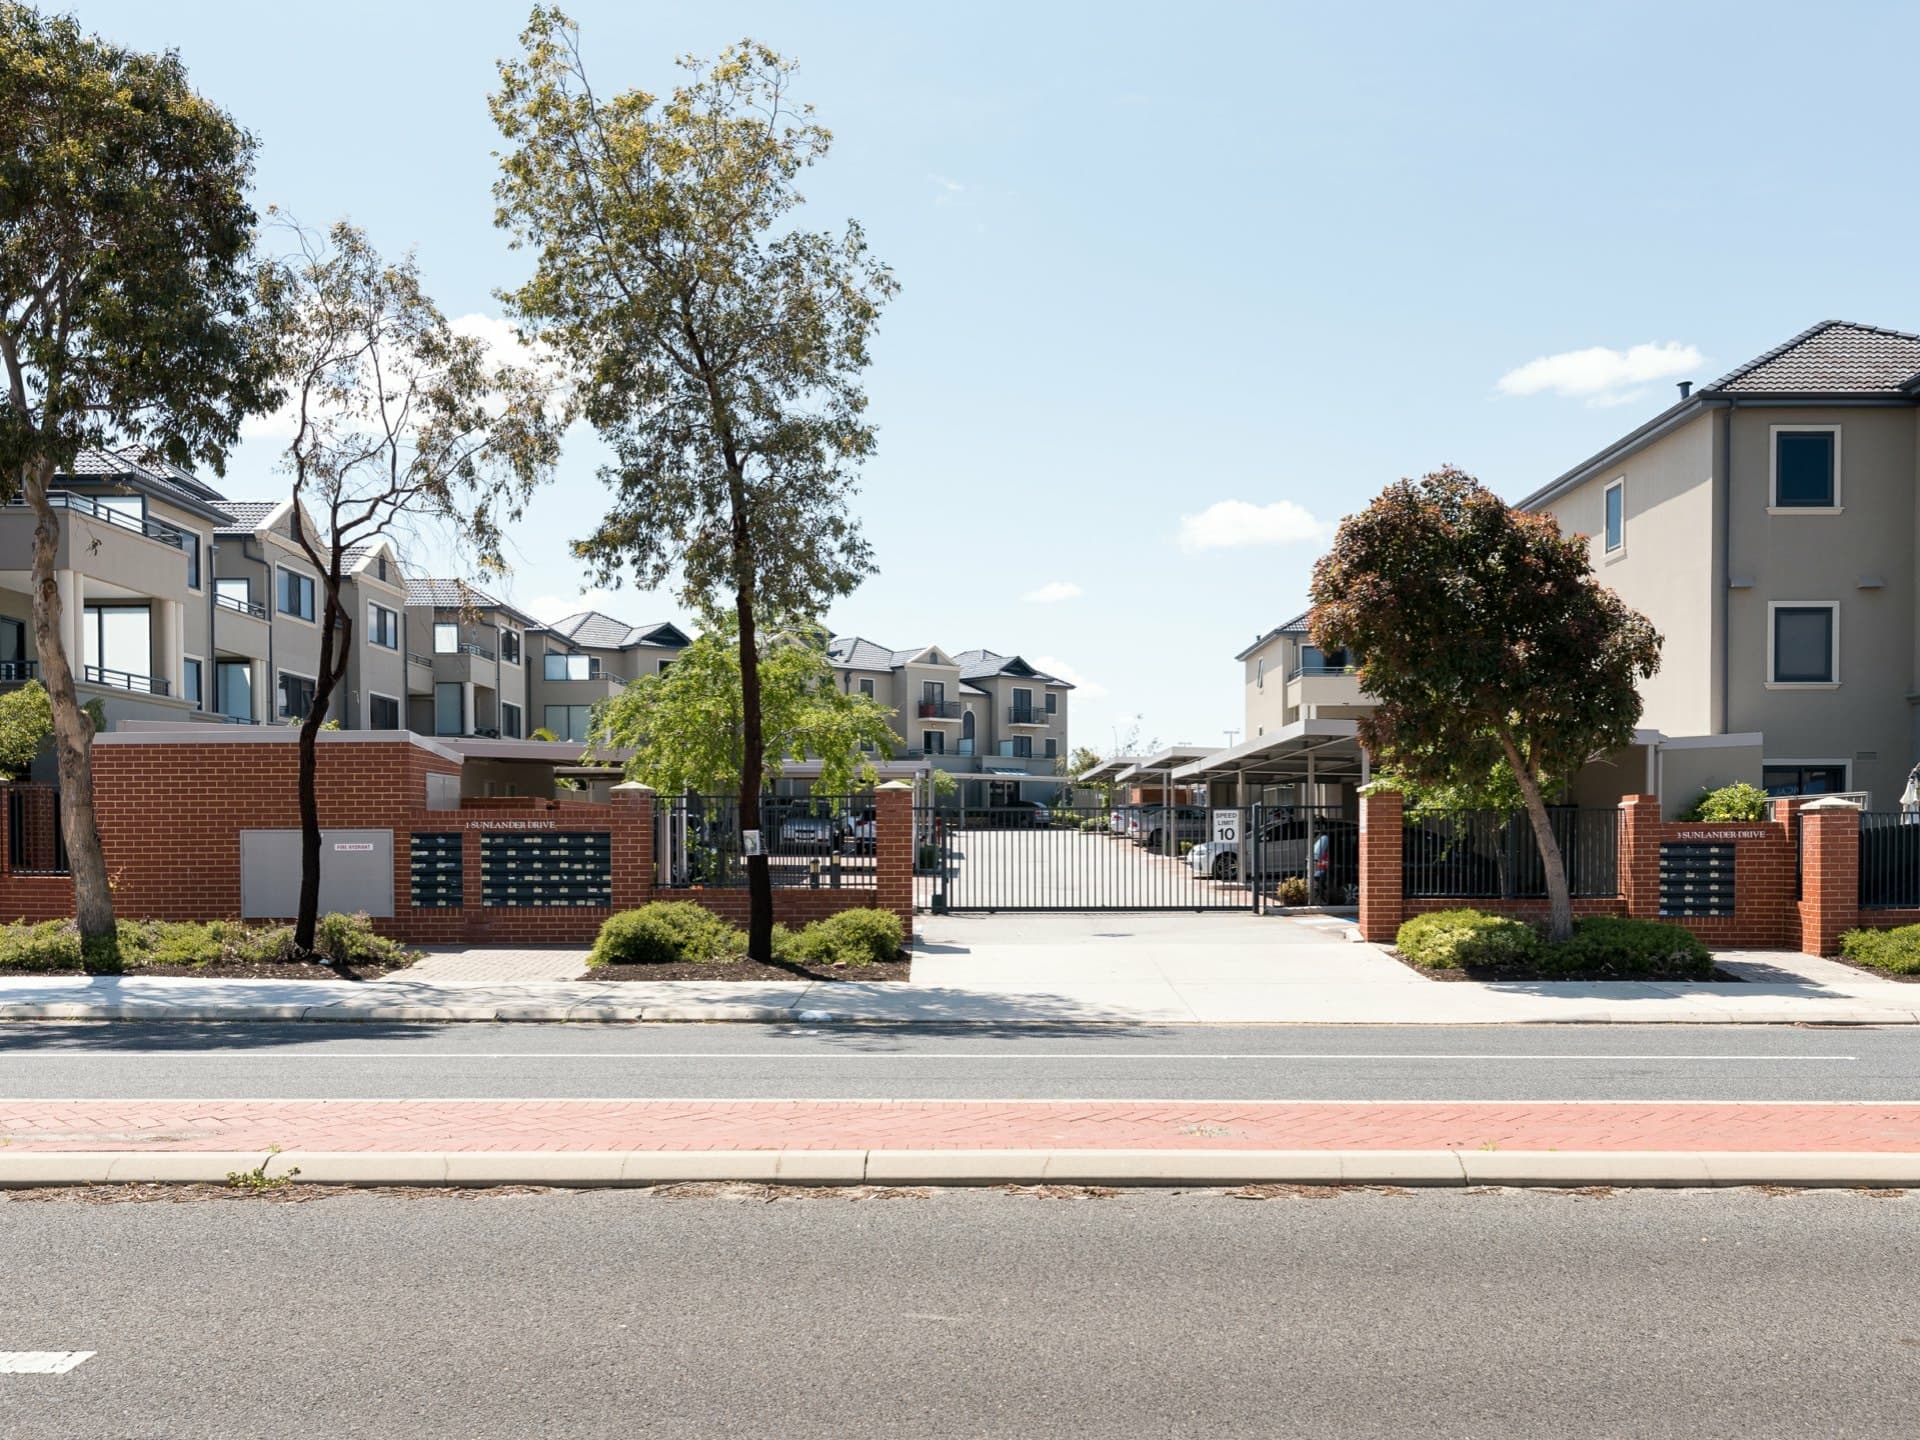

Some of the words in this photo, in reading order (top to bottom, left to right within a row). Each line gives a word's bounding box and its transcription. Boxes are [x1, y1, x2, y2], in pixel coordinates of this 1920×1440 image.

[471, 821, 525, 829] SUNLANDER
[527, 821, 556, 829] DRIVE
[1217, 827, 1235, 840] 10
[1682, 831, 1736, 839] SUNLANDER
[1738, 830, 1766, 838] DRIVE
